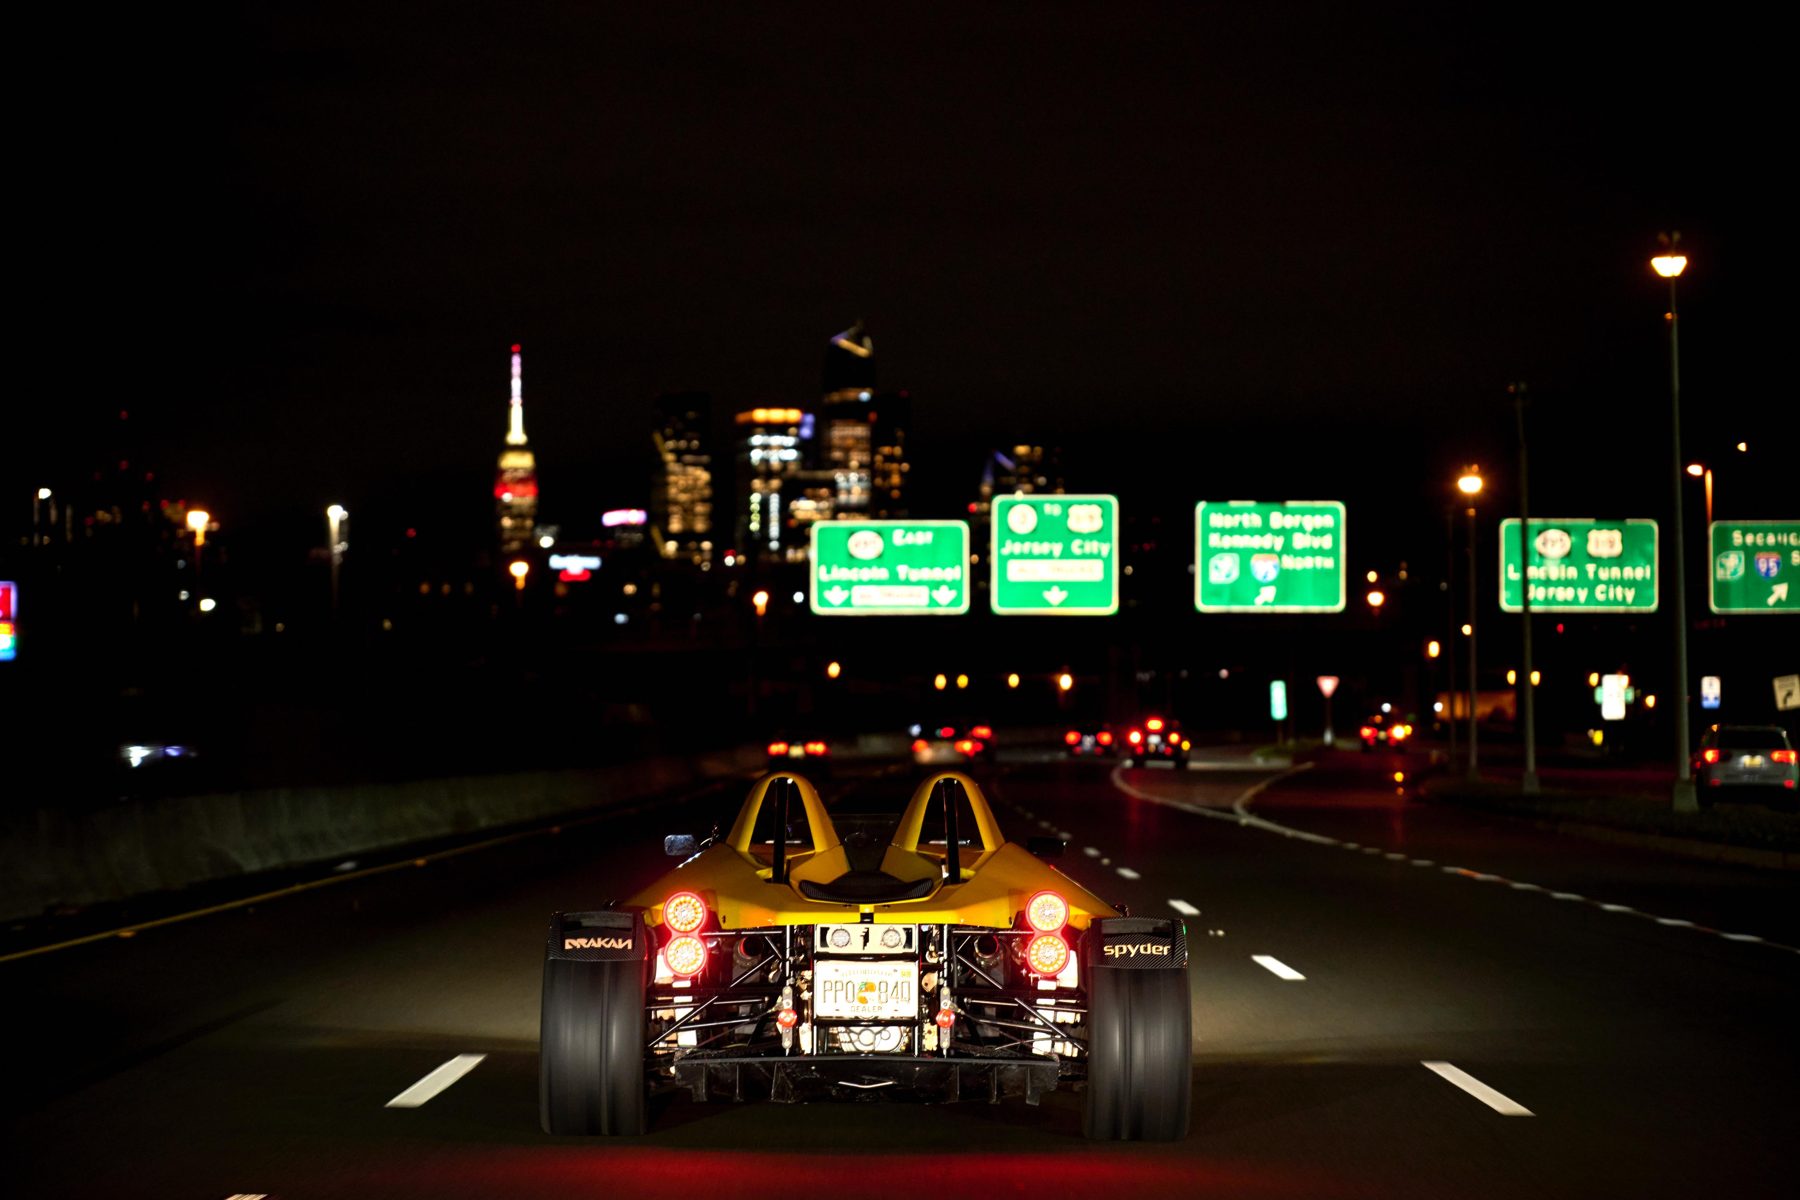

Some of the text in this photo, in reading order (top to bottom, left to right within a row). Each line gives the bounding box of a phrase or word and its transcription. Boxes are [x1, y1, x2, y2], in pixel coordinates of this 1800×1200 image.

[1732, 530, 1800, 546] Secauc
[1000, 539, 1112, 558] Jersey City
[818, 564, 962, 581] Lincoln Tunnel
[1507, 563, 1651, 580] Lncoln Tunnel
[1759, 558, 1778, 577] 95
[1595, 584, 1635, 604] City
[564, 937, 633, 950] DRAKAN
[1103, 943, 1171, 958] spyder
